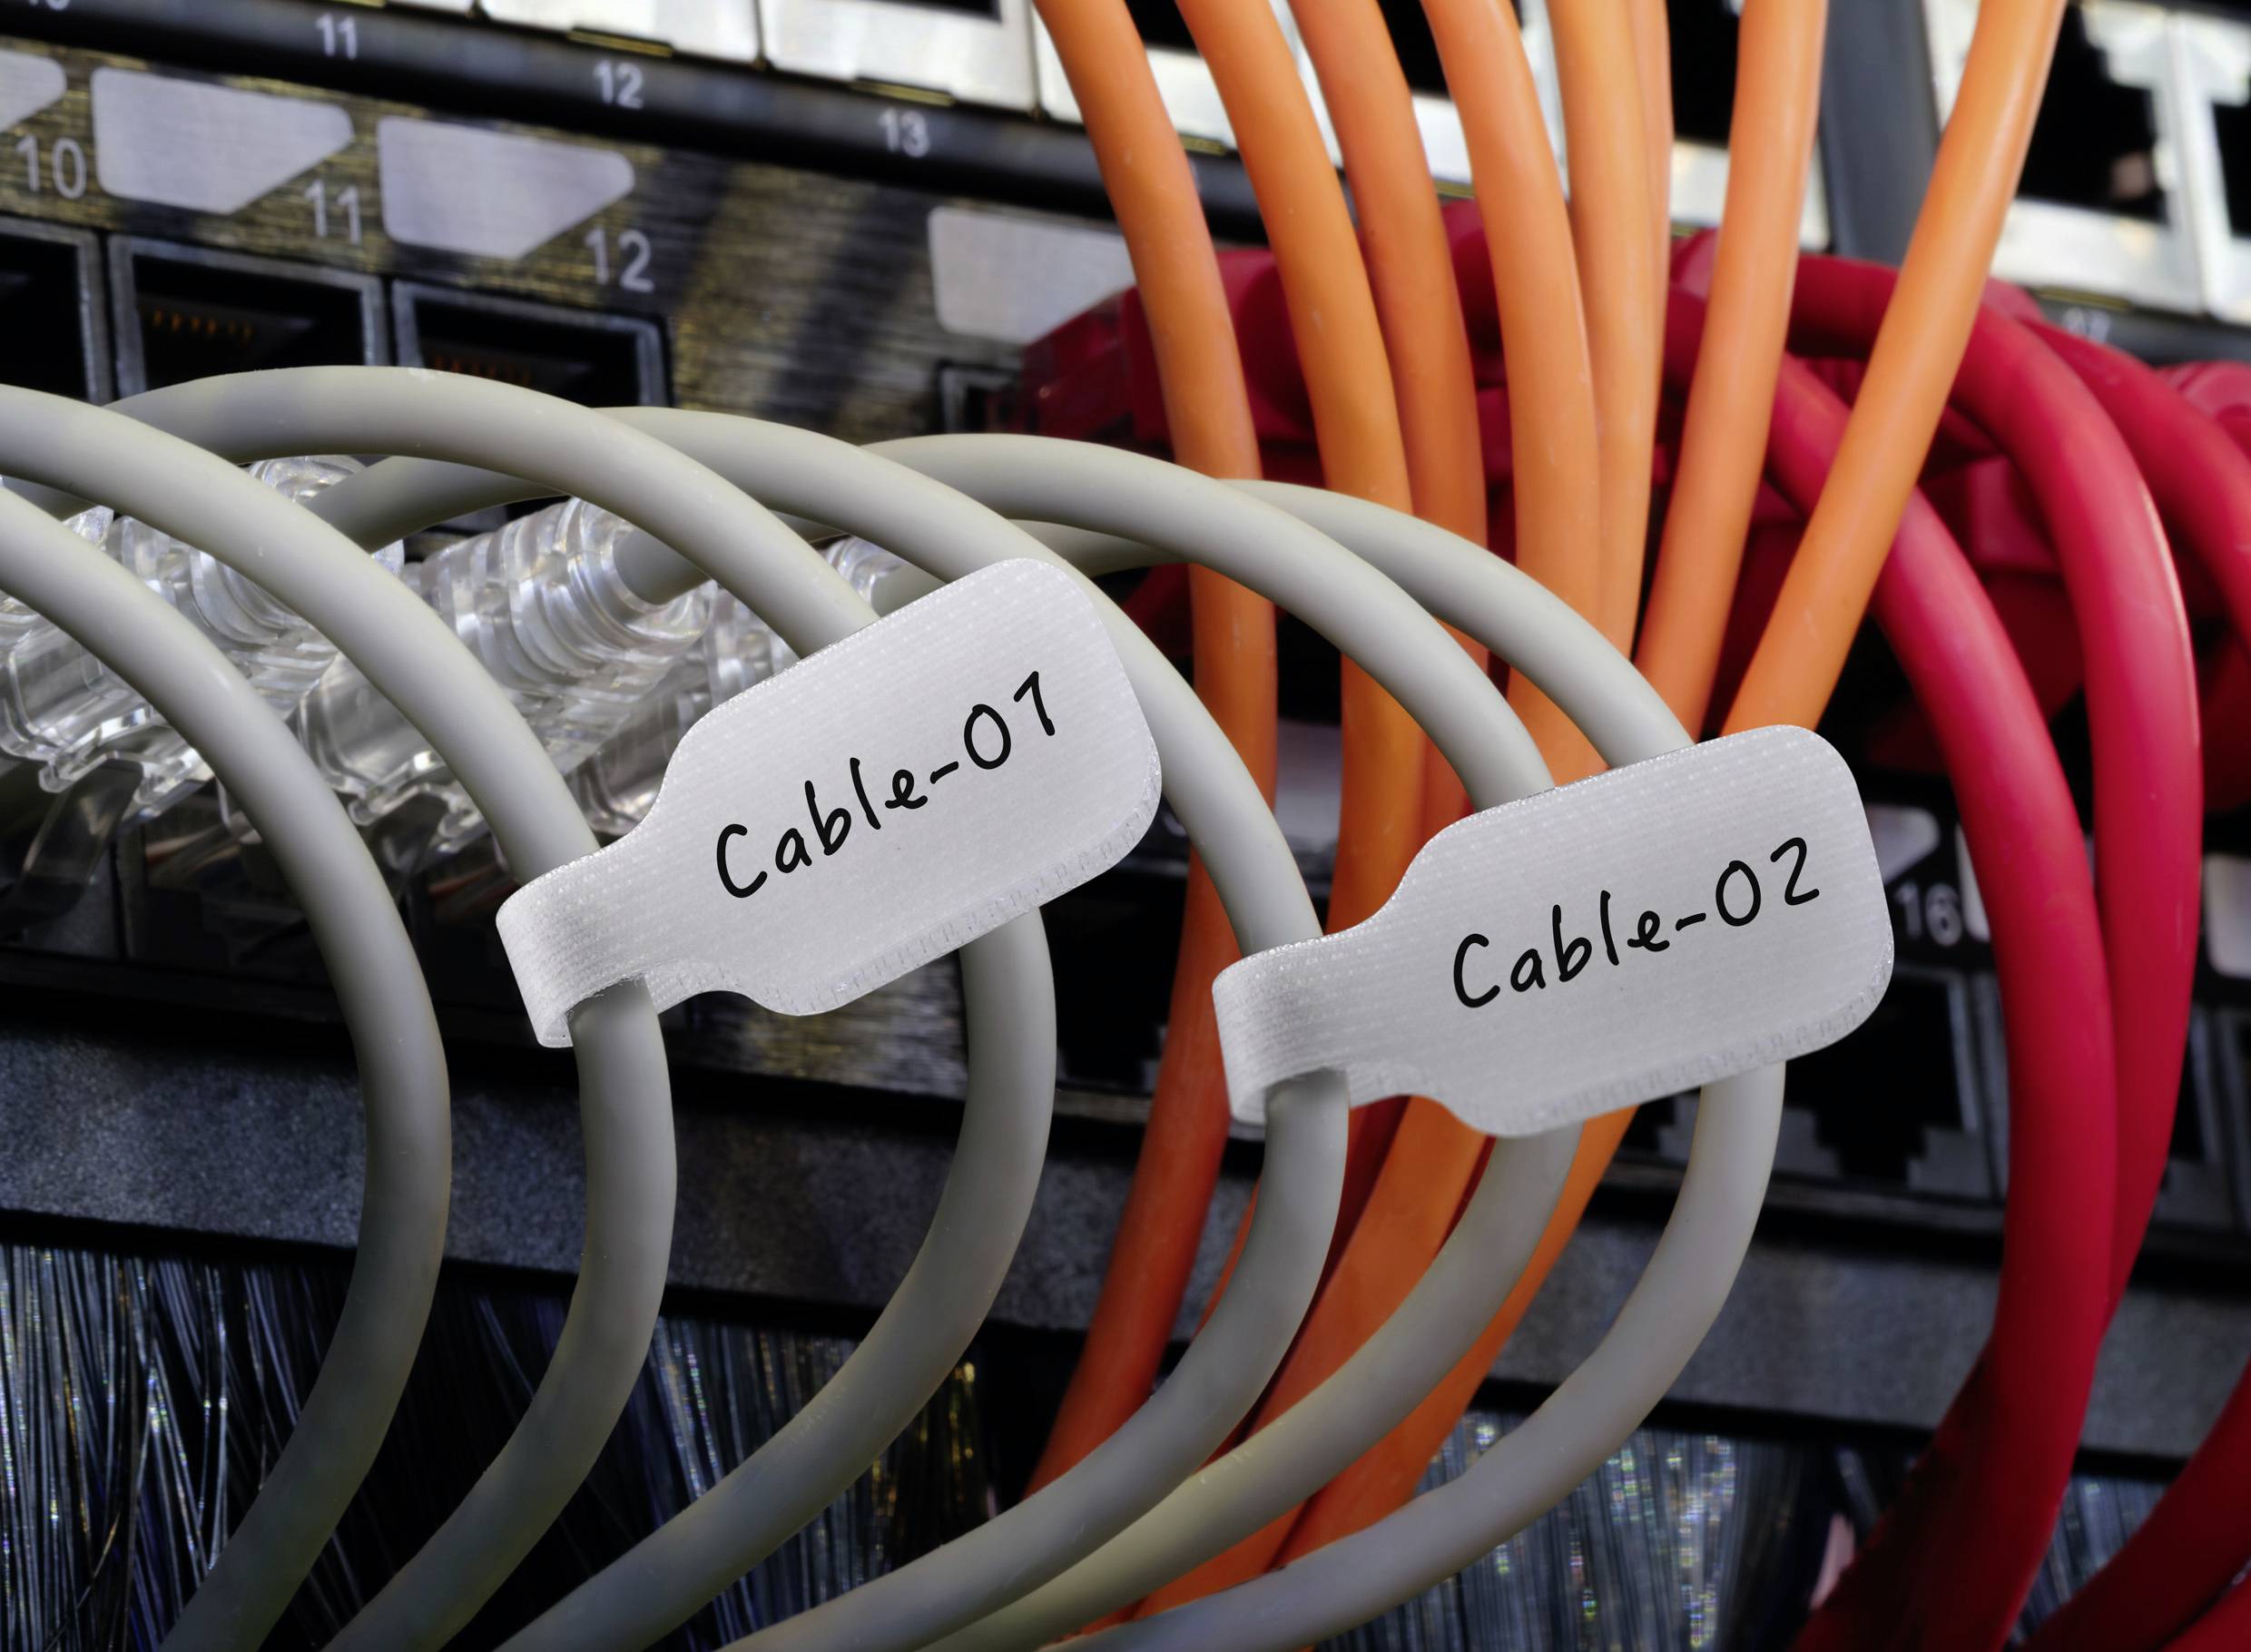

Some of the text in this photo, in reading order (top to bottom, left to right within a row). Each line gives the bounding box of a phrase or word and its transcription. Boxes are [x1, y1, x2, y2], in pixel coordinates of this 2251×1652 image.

[315, 14, 358, 60] 11
[594, 61, 644, 109] 12
[878, 108, 930, 157] 13
[16, 134, 87, 199] 10
[305, 180, 361, 243] 11
[585, 227, 655, 292] 12
[716, 671, 1056, 899] Cable-01
[1453, 837, 1820, 1008] Cable-02
